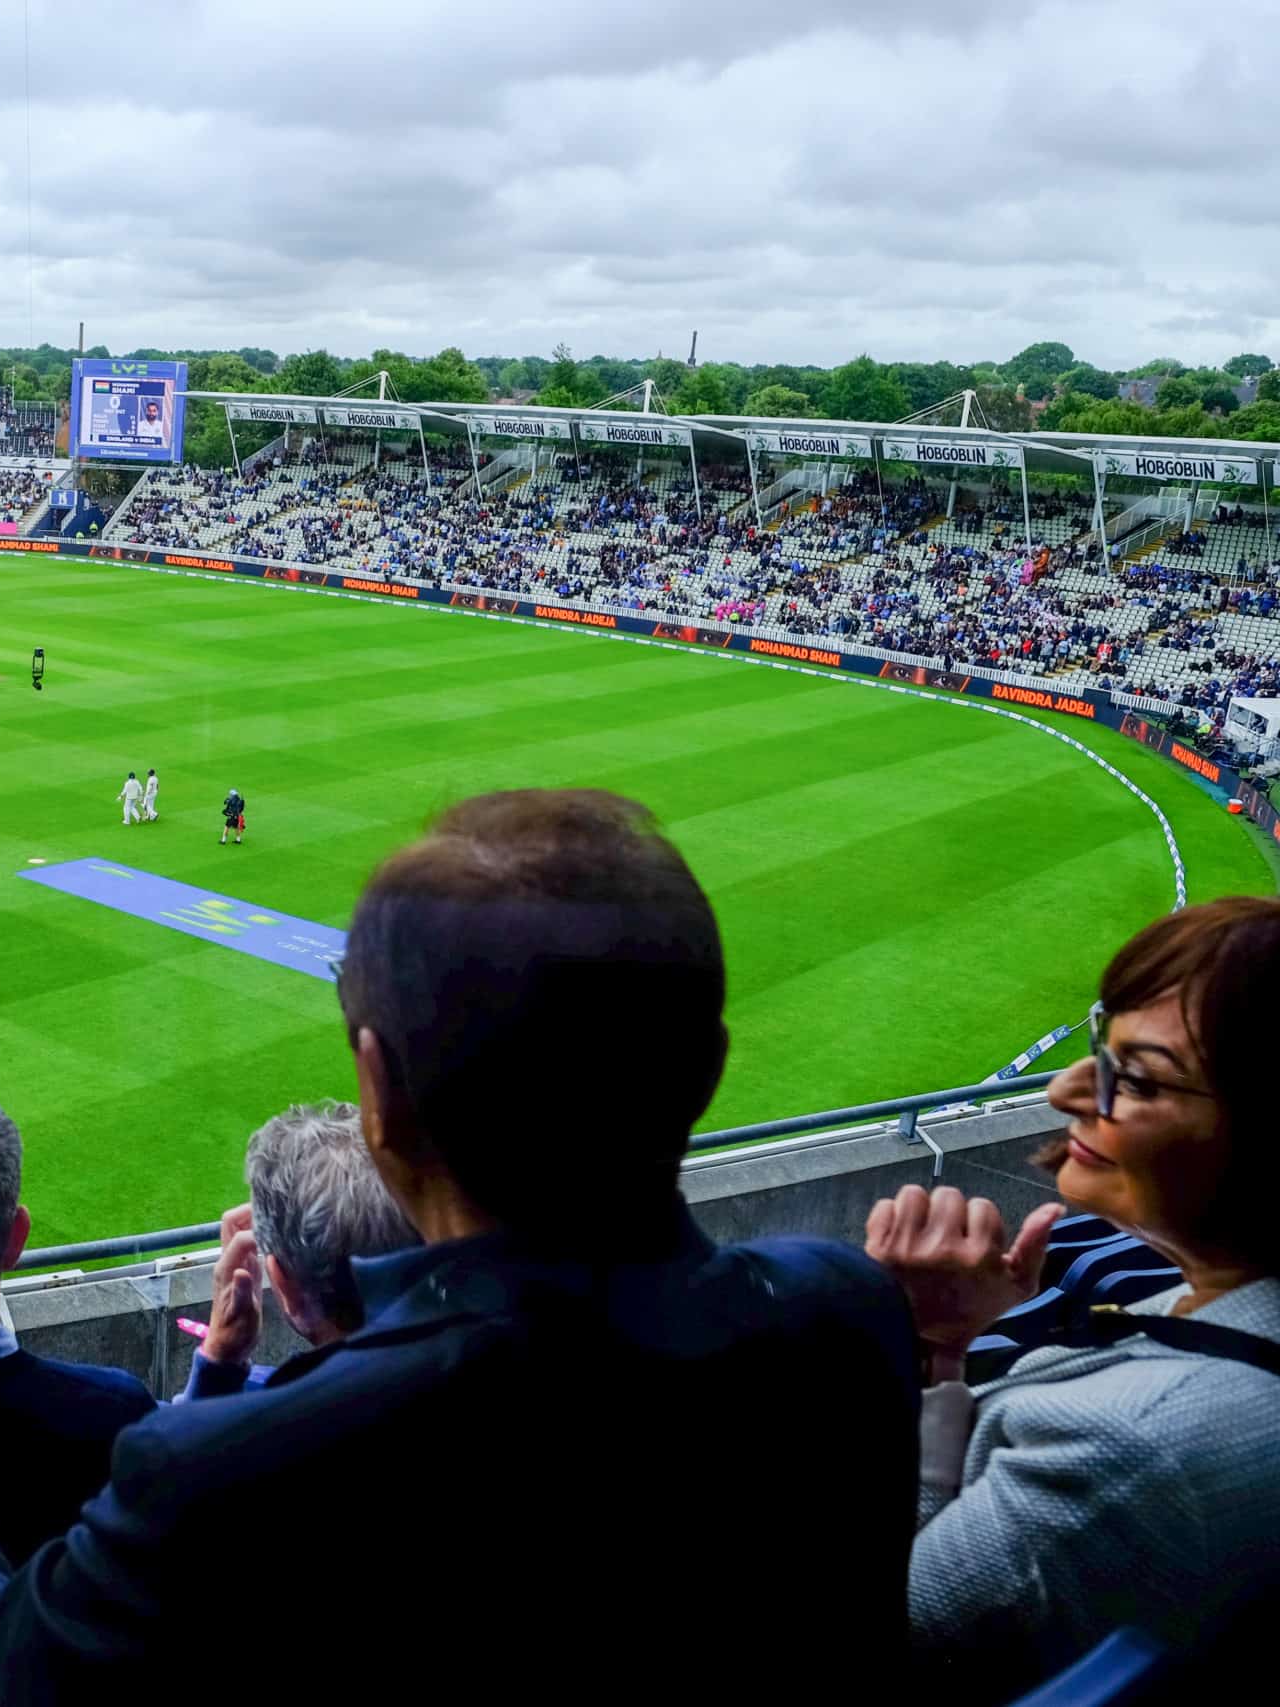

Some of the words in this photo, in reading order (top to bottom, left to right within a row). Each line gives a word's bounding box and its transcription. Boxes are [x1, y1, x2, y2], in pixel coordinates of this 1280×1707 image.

[249, 407, 295, 421] HOBGOBLIN
[346, 413, 397, 427] HOBGOBLIN
[494, 421, 545, 436] HOBGOBLIN
[606, 427, 663, 443] HOBGOBLIN
[778, 437, 840, 455] HOBGOBLIN
[916, 445, 987, 464] HOBGOBLIN
[1135, 458, 1216, 480] HOBGOBLIN
[32, 543, 60, 552] SHAMI
[165, 556, 203, 568] RAVINDRA
[204, 560, 234, 571] JADEJA
[343, 578, 391, 593] MOHAMMAD
[392, 586, 419, 598] SHAMI
[535, 606, 580, 622] RAVINDRA
[581, 613, 616, 628] JADEJA
[751, 639, 809, 660] MOHAMMAD
[809, 651, 841, 666] SHAMI
[992, 685, 1052, 708] RAVINDRA
[1054, 698, 1095, 719] JADEJA
